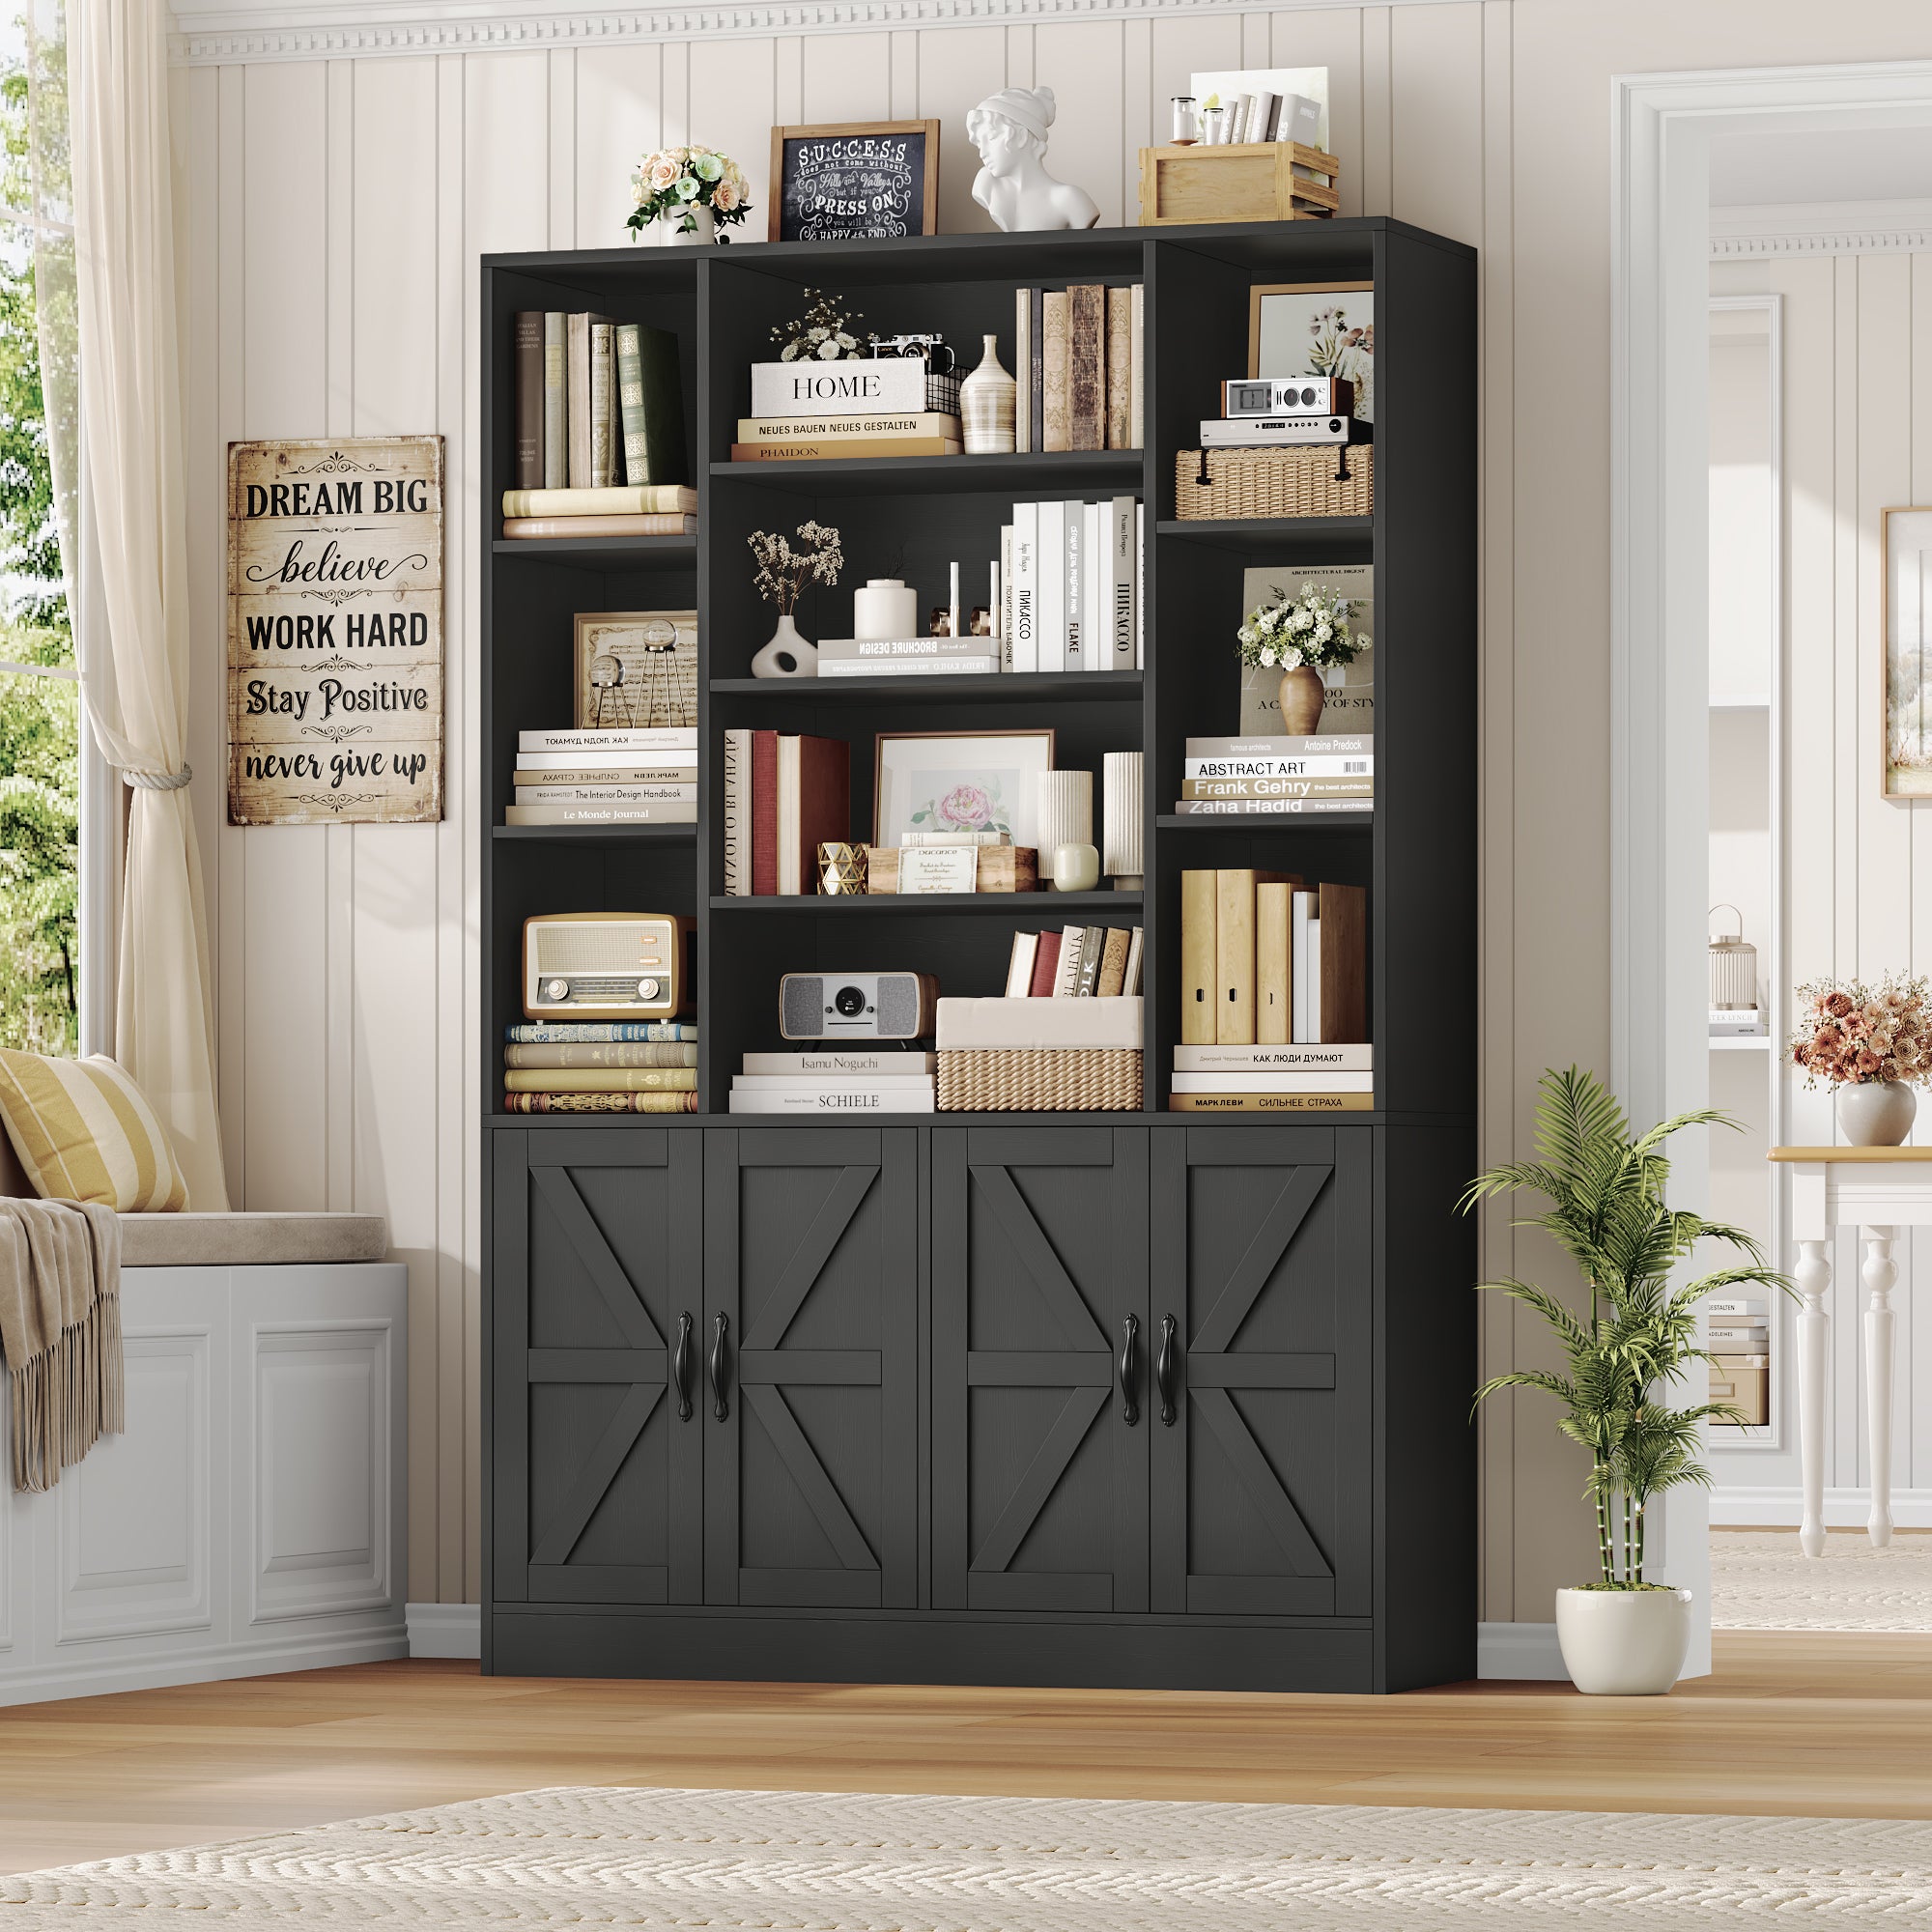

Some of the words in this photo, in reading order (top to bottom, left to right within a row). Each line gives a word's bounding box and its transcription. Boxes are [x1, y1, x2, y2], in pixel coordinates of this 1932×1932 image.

[799, 140, 906, 167] SUCCESS
[801, 164, 819, 177] does
[824, 160, 839, 170] not
[868, 160, 904, 172] without
[836, 188, 847, 197] but
[850, 187, 857, 196] if
[814, 193, 868, 216] PRESS
[872, 190, 895, 213] ON
[848, 216, 862, 227] will
[865, 216, 872, 227] be
[819, 229, 851, 241] HAPPY
[867, 228, 887, 240] END
[793, 375, 881, 401] HOME
[758, 425, 790, 436] NEUES
[793, 423, 826, 434] BAUEN
[829, 422, 861, 433] NEUES
[864, 419, 917, 432] GESTALTEN
[759, 446, 819, 458] PHAIDON
[246, 482, 363, 518] DREAM
[374, 479, 428, 513] BIG
[246, 540, 428, 582] believe
[1019, 590, 1031, 639] ПИКАССО
[1117, 583, 1130, 652] ПИКАССО
[246, 615, 335, 650] WORK
[347, 612, 428, 648] HARD
[1069, 622, 1079, 653] FLAKE
[246, 679, 311, 720] Stay
[319, 678, 428, 721] Positive
[1258, 700, 1267, 710] A
[1333, 698, 1350, 708] OF
[1248, 743, 1271, 752] architects
[1304, 739, 1331, 752] Antoine
[1333, 739, 1362, 751] Predock
[246, 753, 324, 780] never
[329, 749, 388, 788] give
[392, 753, 426, 785] up
[1199, 762, 1274, 776] ABSTRACT
[1278, 762, 1307, 775] ART
[575, 790, 588, 800] The
[589, 789, 616, 800] Interior
[616, 789, 641, 802] Design
[643, 788, 681, 799] Handbook
[1194, 780, 1248, 795] Frank
[1253, 780, 1311, 797] Gehry
[1189, 800, 1239, 814] Zaha
[1245, 799, 1303, 813] Hadid
[563, 810, 577, 820] Le
[578, 810, 611, 819] Monde
[612, 810, 649, 820] Journal
[802, 1058, 831, 1070] Isamu
[834, 1057, 878, 1072] Noguchi
[1253, 1054, 1271, 1064] КАК
[1272, 1054, 1301, 1064] ЛЮДИ
[1303, 1053, 1344, 1064] ДУМАЮТ
[818, 1094, 880, 1108] SCHIELE
[1259, 1098, 1304, 1107] СИЛЬНЕЕ
[1307, 1098, 1343, 1107] СТРАХА
